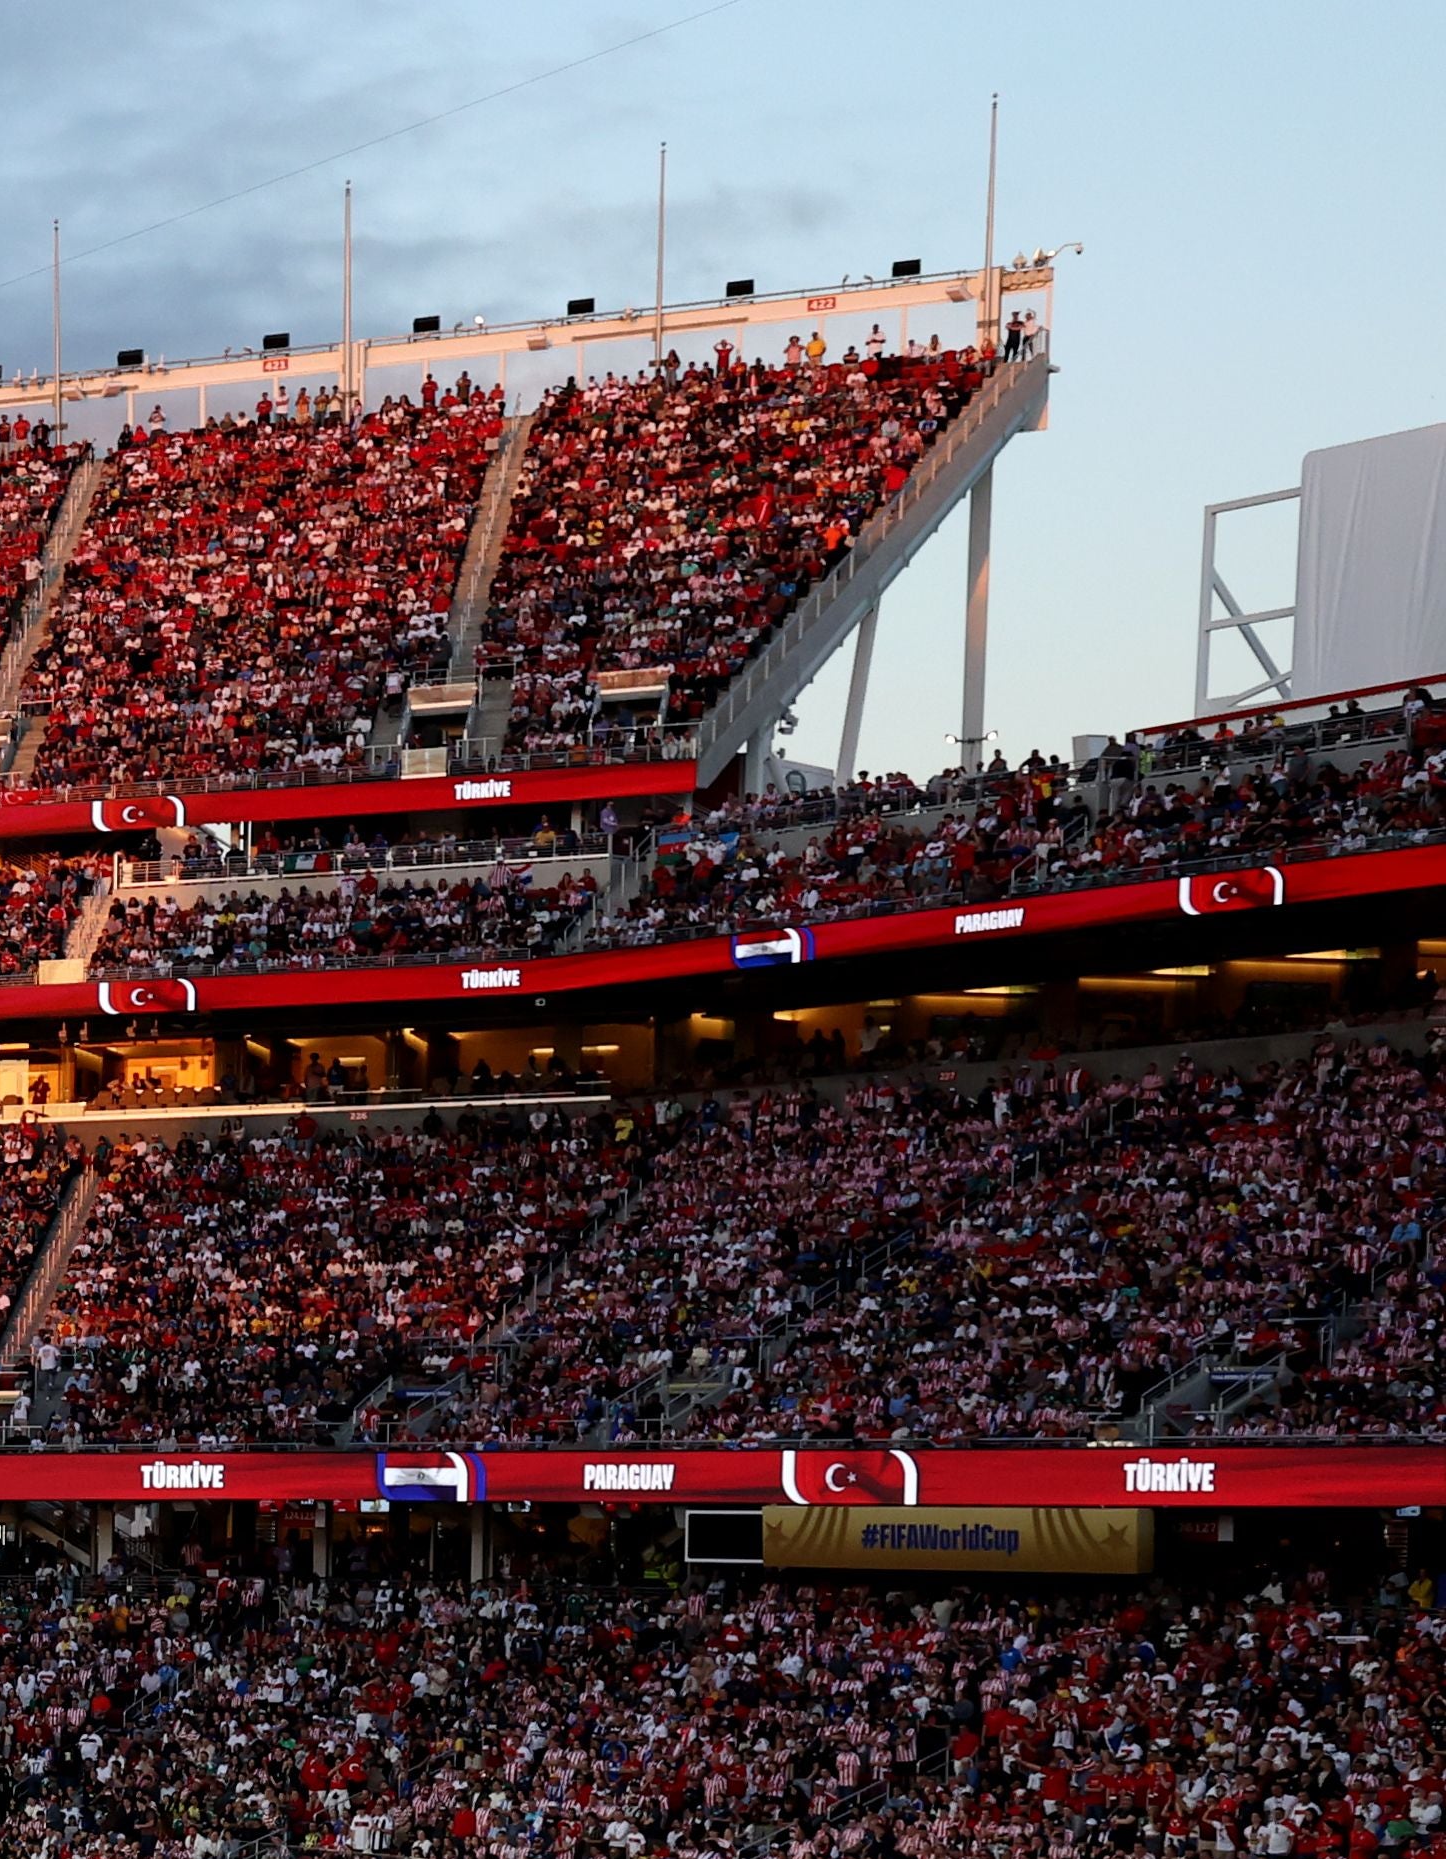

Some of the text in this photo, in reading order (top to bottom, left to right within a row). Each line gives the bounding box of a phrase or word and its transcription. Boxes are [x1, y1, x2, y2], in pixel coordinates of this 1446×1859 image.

[810, 299, 833, 309] 422
[265, 360, 287, 371] 421
[454, 779, 510, 800] TÜRKİYE
[956, 908, 1023, 934] PARAGUAY
[462, 968, 520, 988] TÜRKİYE
[141, 1461, 224, 1488] TÜRKİYE
[584, 1464, 674, 1490] PARAGUAY
[1124, 1458, 1214, 1491] TÜRKİYE
[862, 1524, 1019, 1555] #FIFAWorldCup
